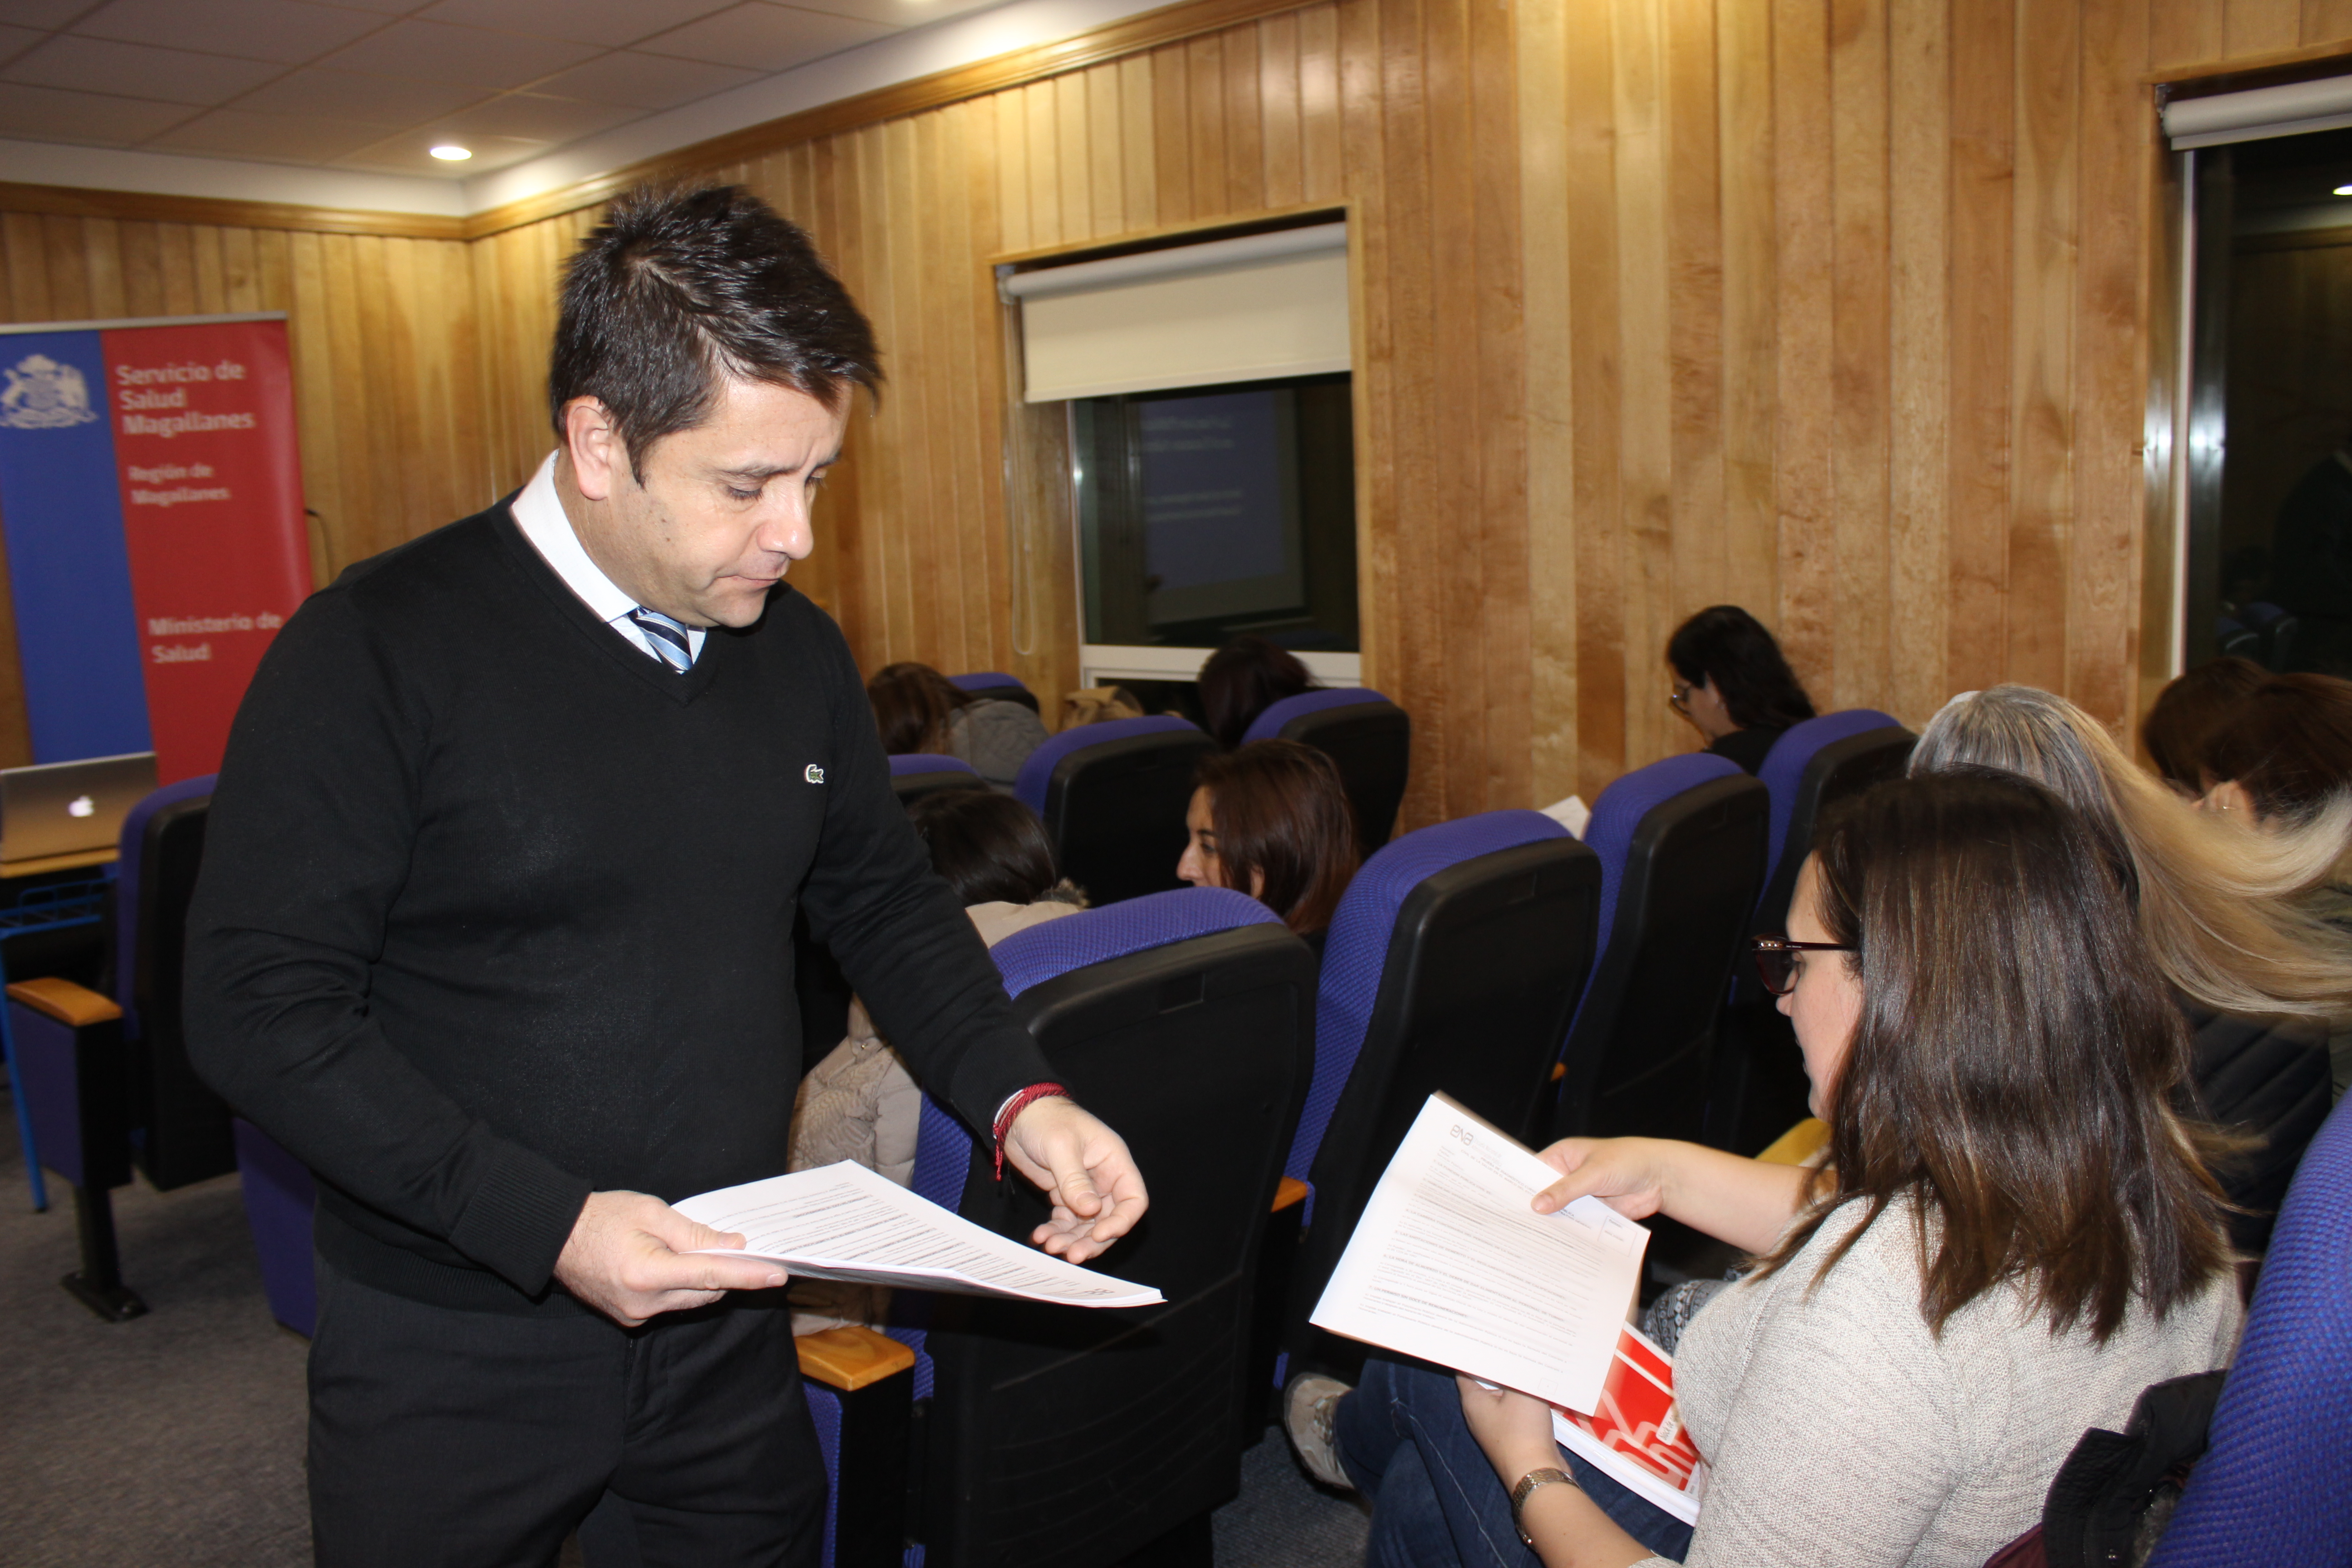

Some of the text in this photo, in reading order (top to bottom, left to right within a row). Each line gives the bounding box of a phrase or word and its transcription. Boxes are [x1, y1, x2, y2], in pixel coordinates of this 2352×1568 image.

[116, 359, 245, 386] Servicio de
[119, 389, 186, 410] Salud
[122, 411, 255, 437] Magallanes
[128, 464, 214, 485] Región de
[132, 487, 230, 507] Magallanes
[149, 611, 282, 636] Ministerio de
[152, 643, 209, 663] Salud
